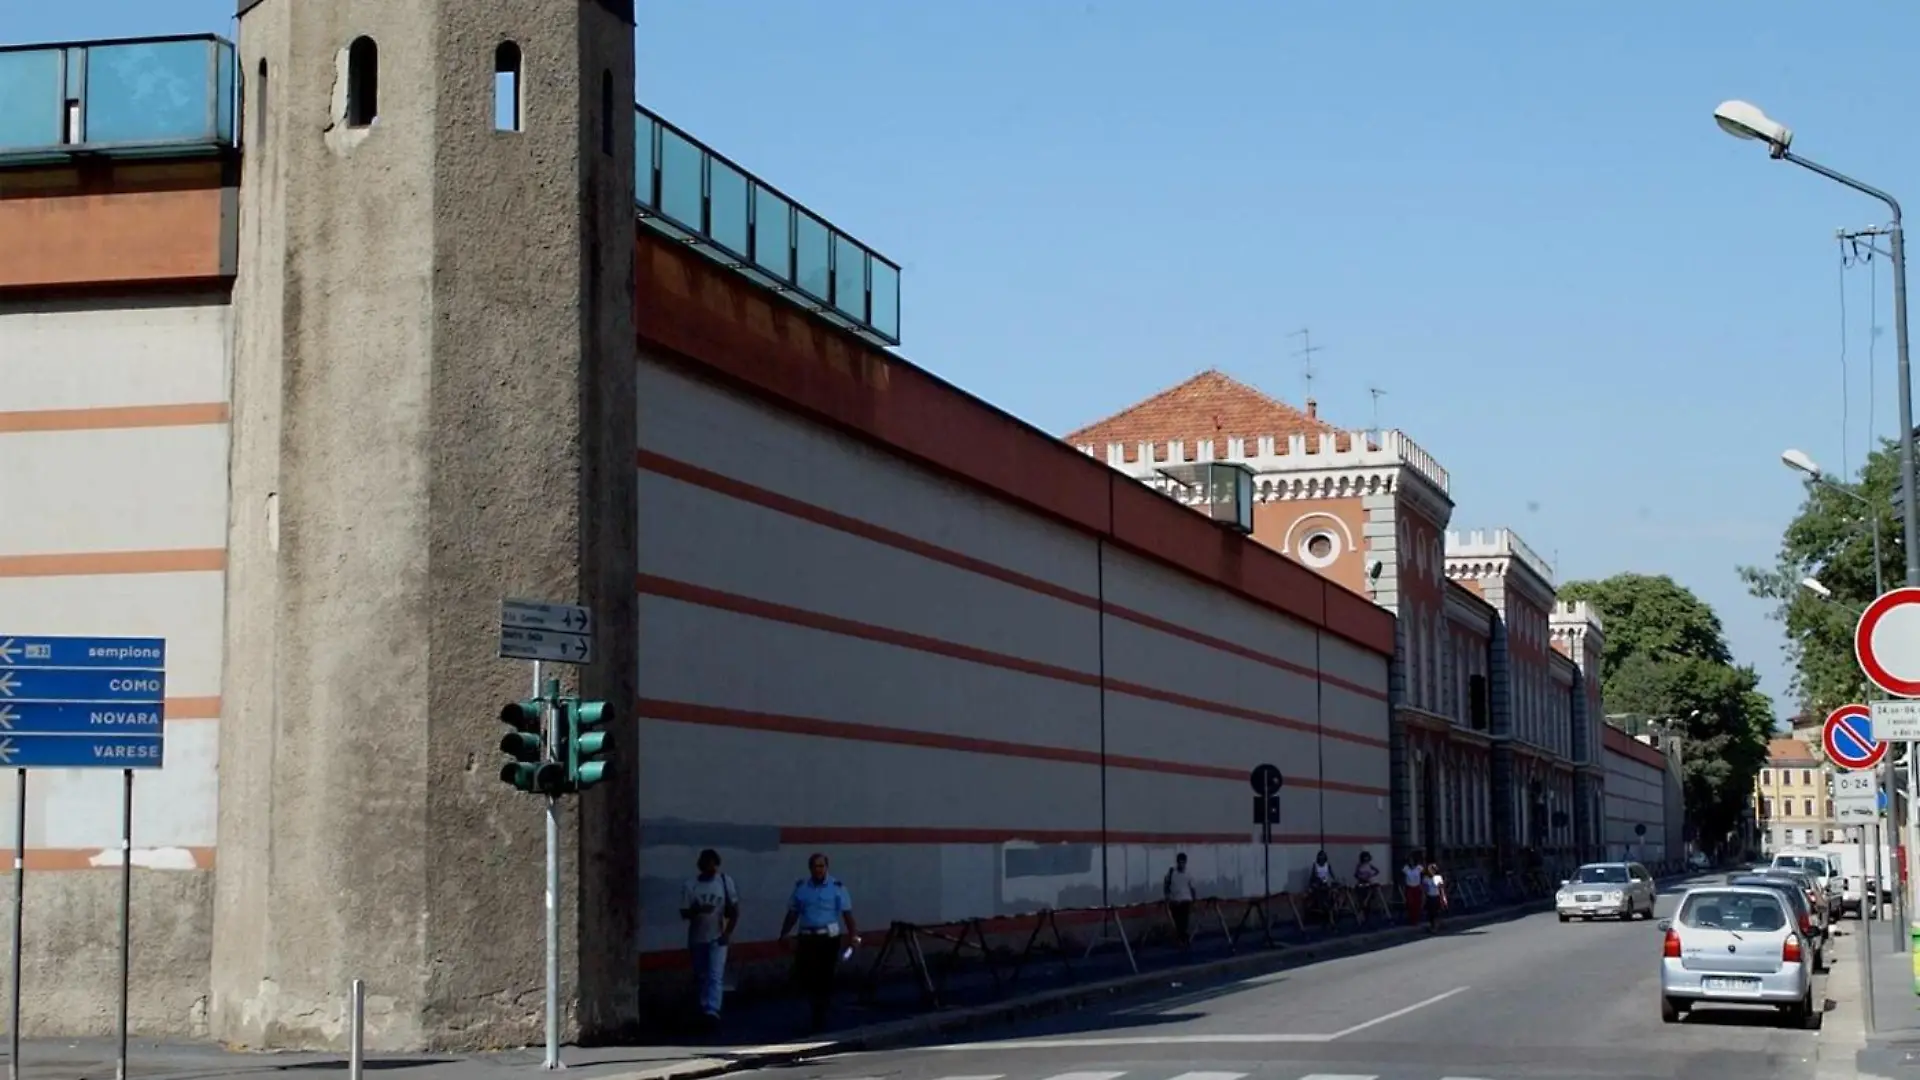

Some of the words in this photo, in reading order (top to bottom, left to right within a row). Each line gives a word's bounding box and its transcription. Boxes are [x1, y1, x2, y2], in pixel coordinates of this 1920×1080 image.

[88, 646, 161, 660] sempione
[109, 679, 161, 692] COMO
[90, 711, 159, 725] NOVARA
[93, 745, 160, 758] VARESE
